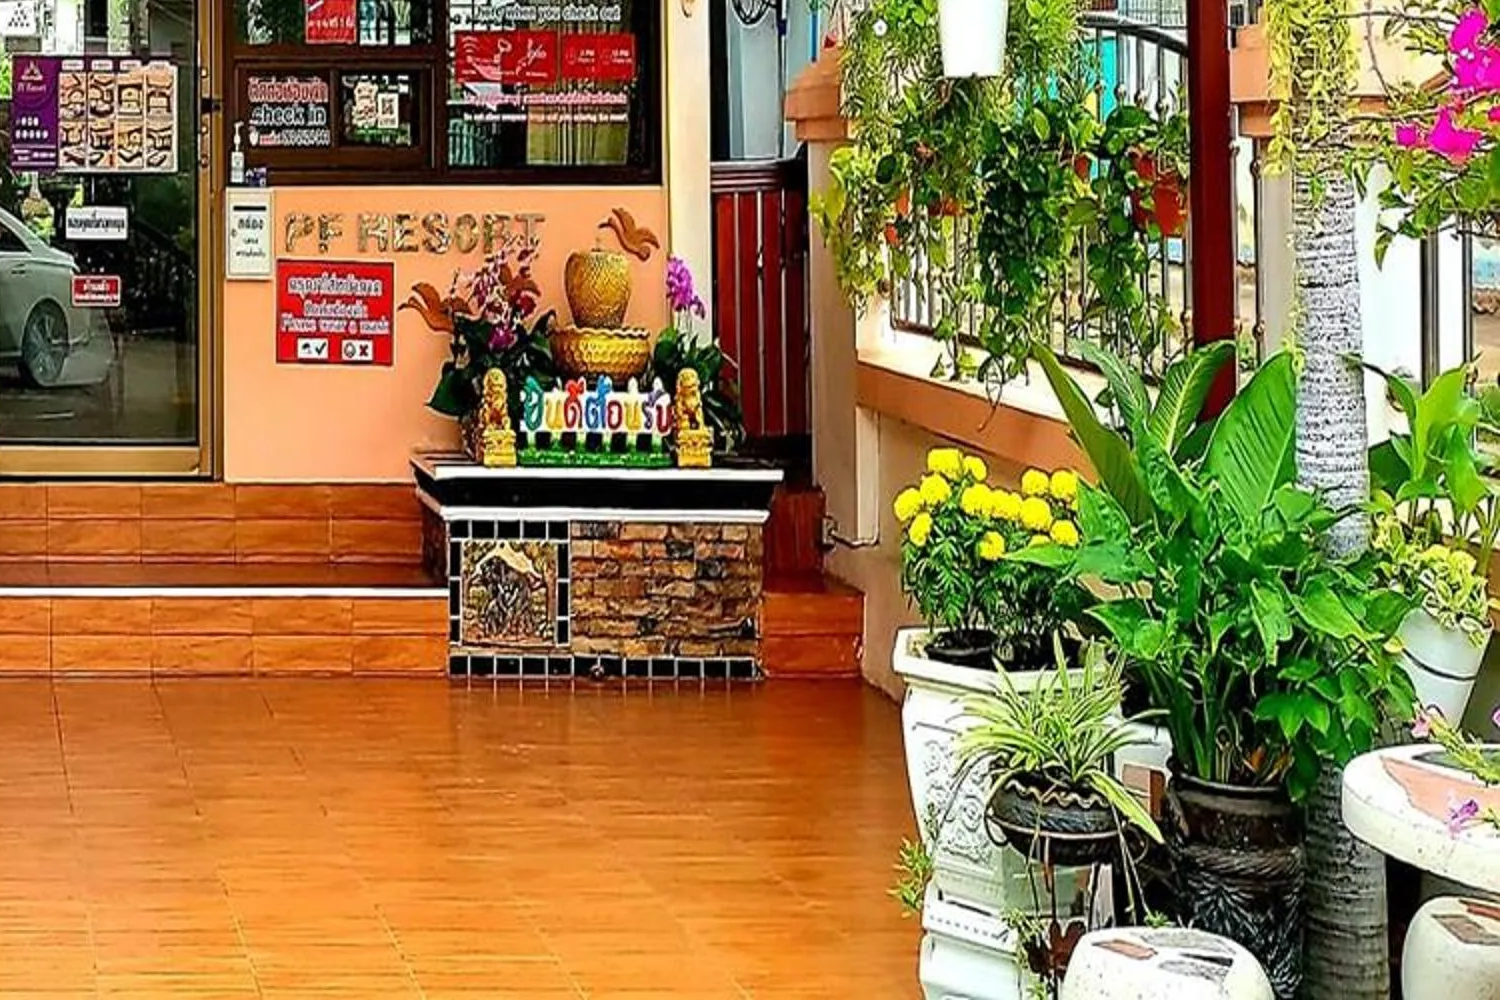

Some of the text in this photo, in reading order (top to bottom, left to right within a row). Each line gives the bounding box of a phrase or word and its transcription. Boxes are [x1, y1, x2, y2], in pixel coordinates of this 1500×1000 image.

[357, 211, 546, 255] RESORT
[520, 374, 670, 434] ยินดีต้อนรับ
